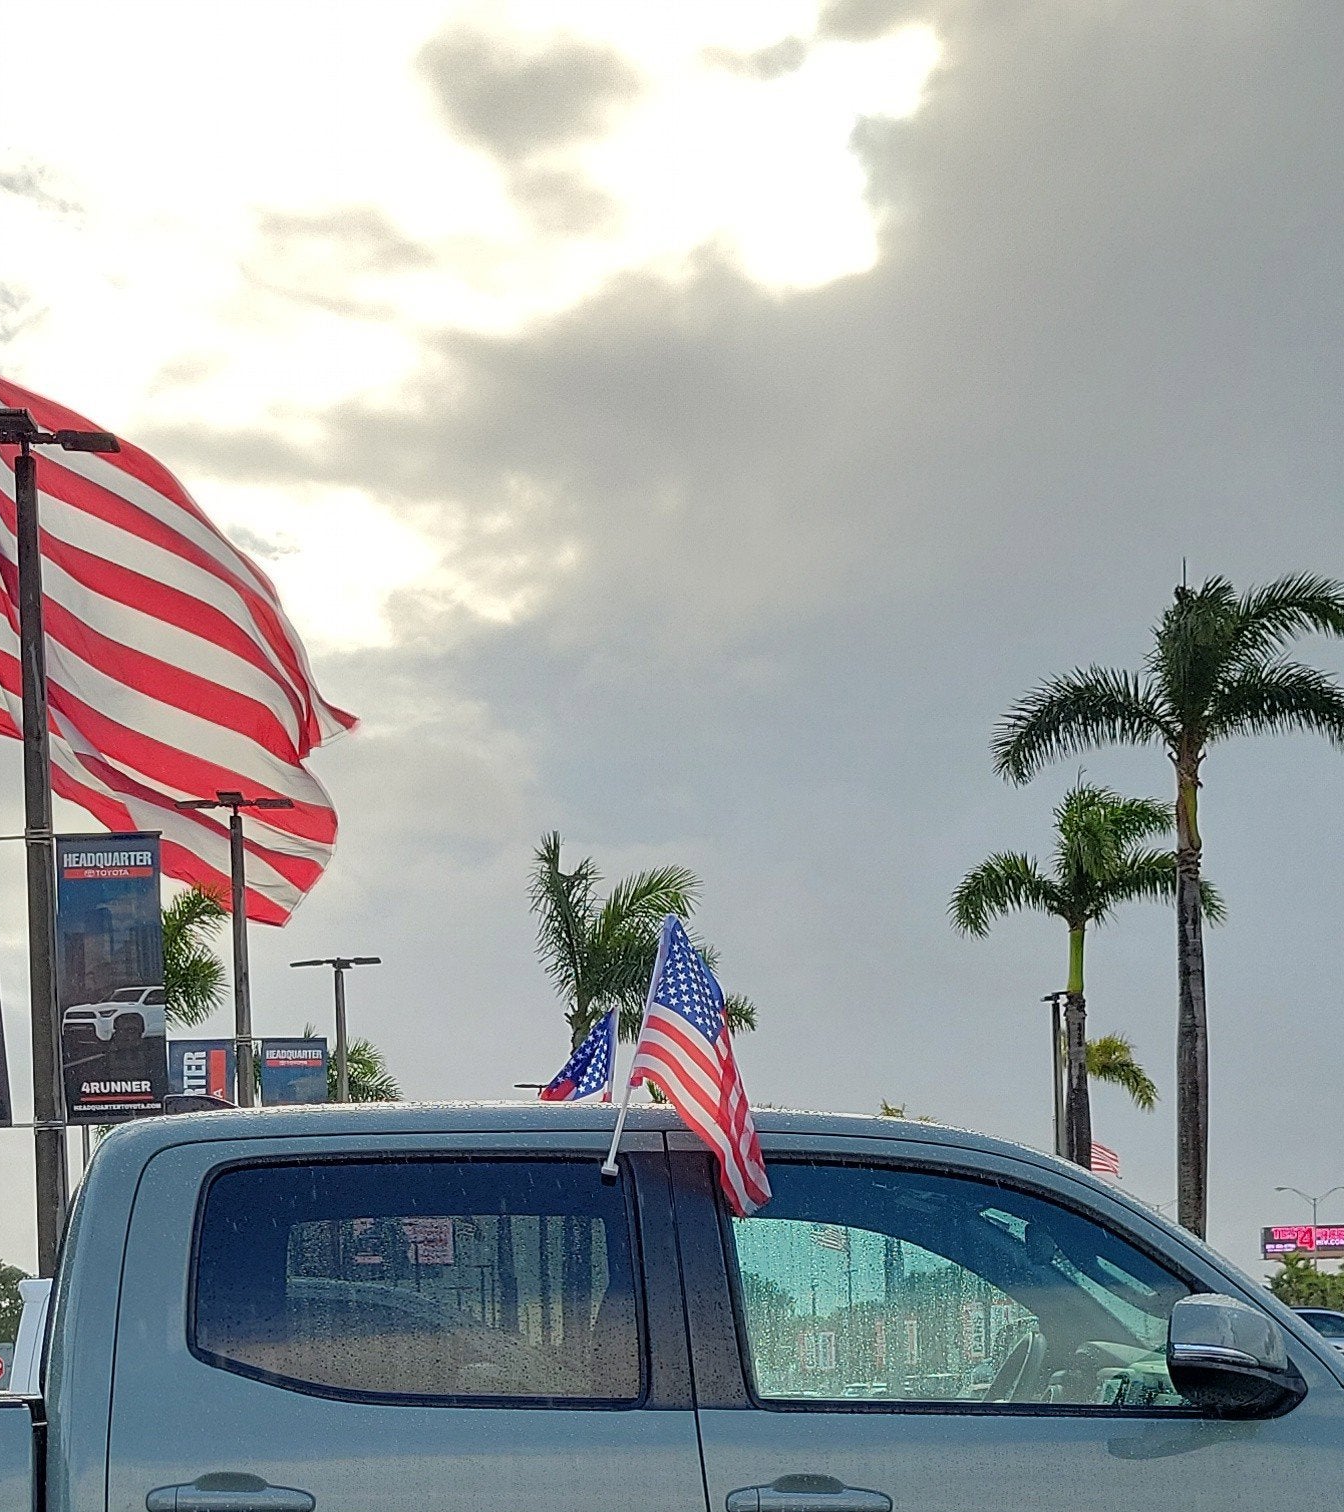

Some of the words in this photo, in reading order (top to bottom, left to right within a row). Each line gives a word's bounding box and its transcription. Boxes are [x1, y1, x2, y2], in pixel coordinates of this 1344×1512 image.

[63, 851, 152, 868] HEADQUARTER
[96, 869, 129, 877] TOYOTA
[81, 1081, 152, 1094] 4RUNNER
